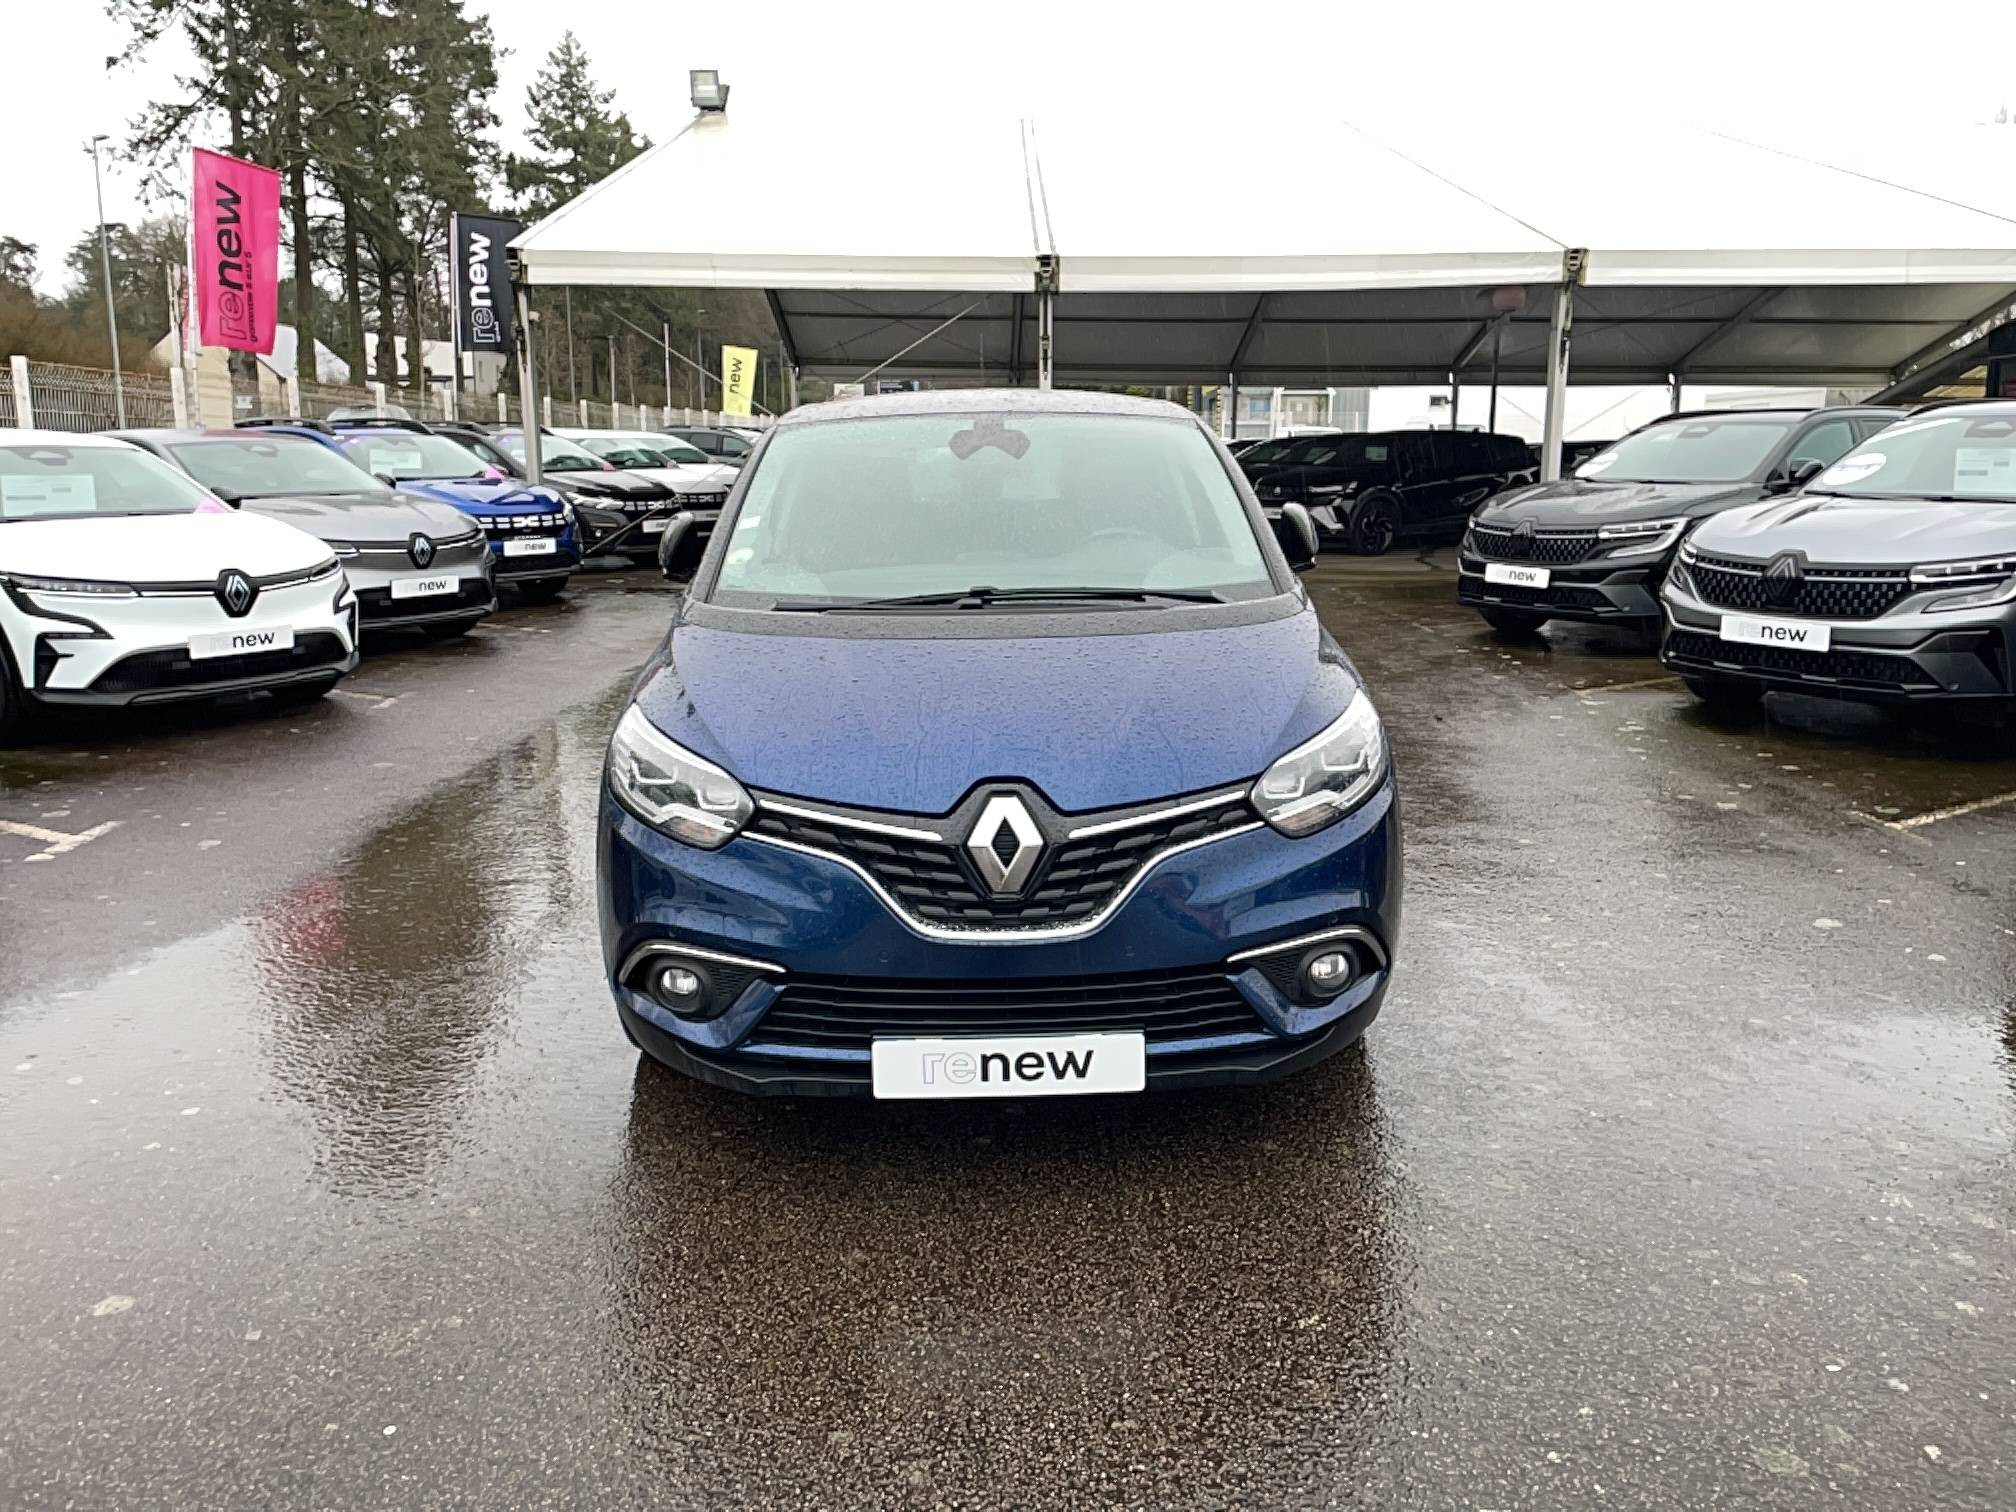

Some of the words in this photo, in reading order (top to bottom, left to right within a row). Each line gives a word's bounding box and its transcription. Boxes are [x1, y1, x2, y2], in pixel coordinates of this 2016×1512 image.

[215, 179, 248, 341] renew
[468, 231, 496, 344] renew
[922, 1050, 1095, 1085] renew
